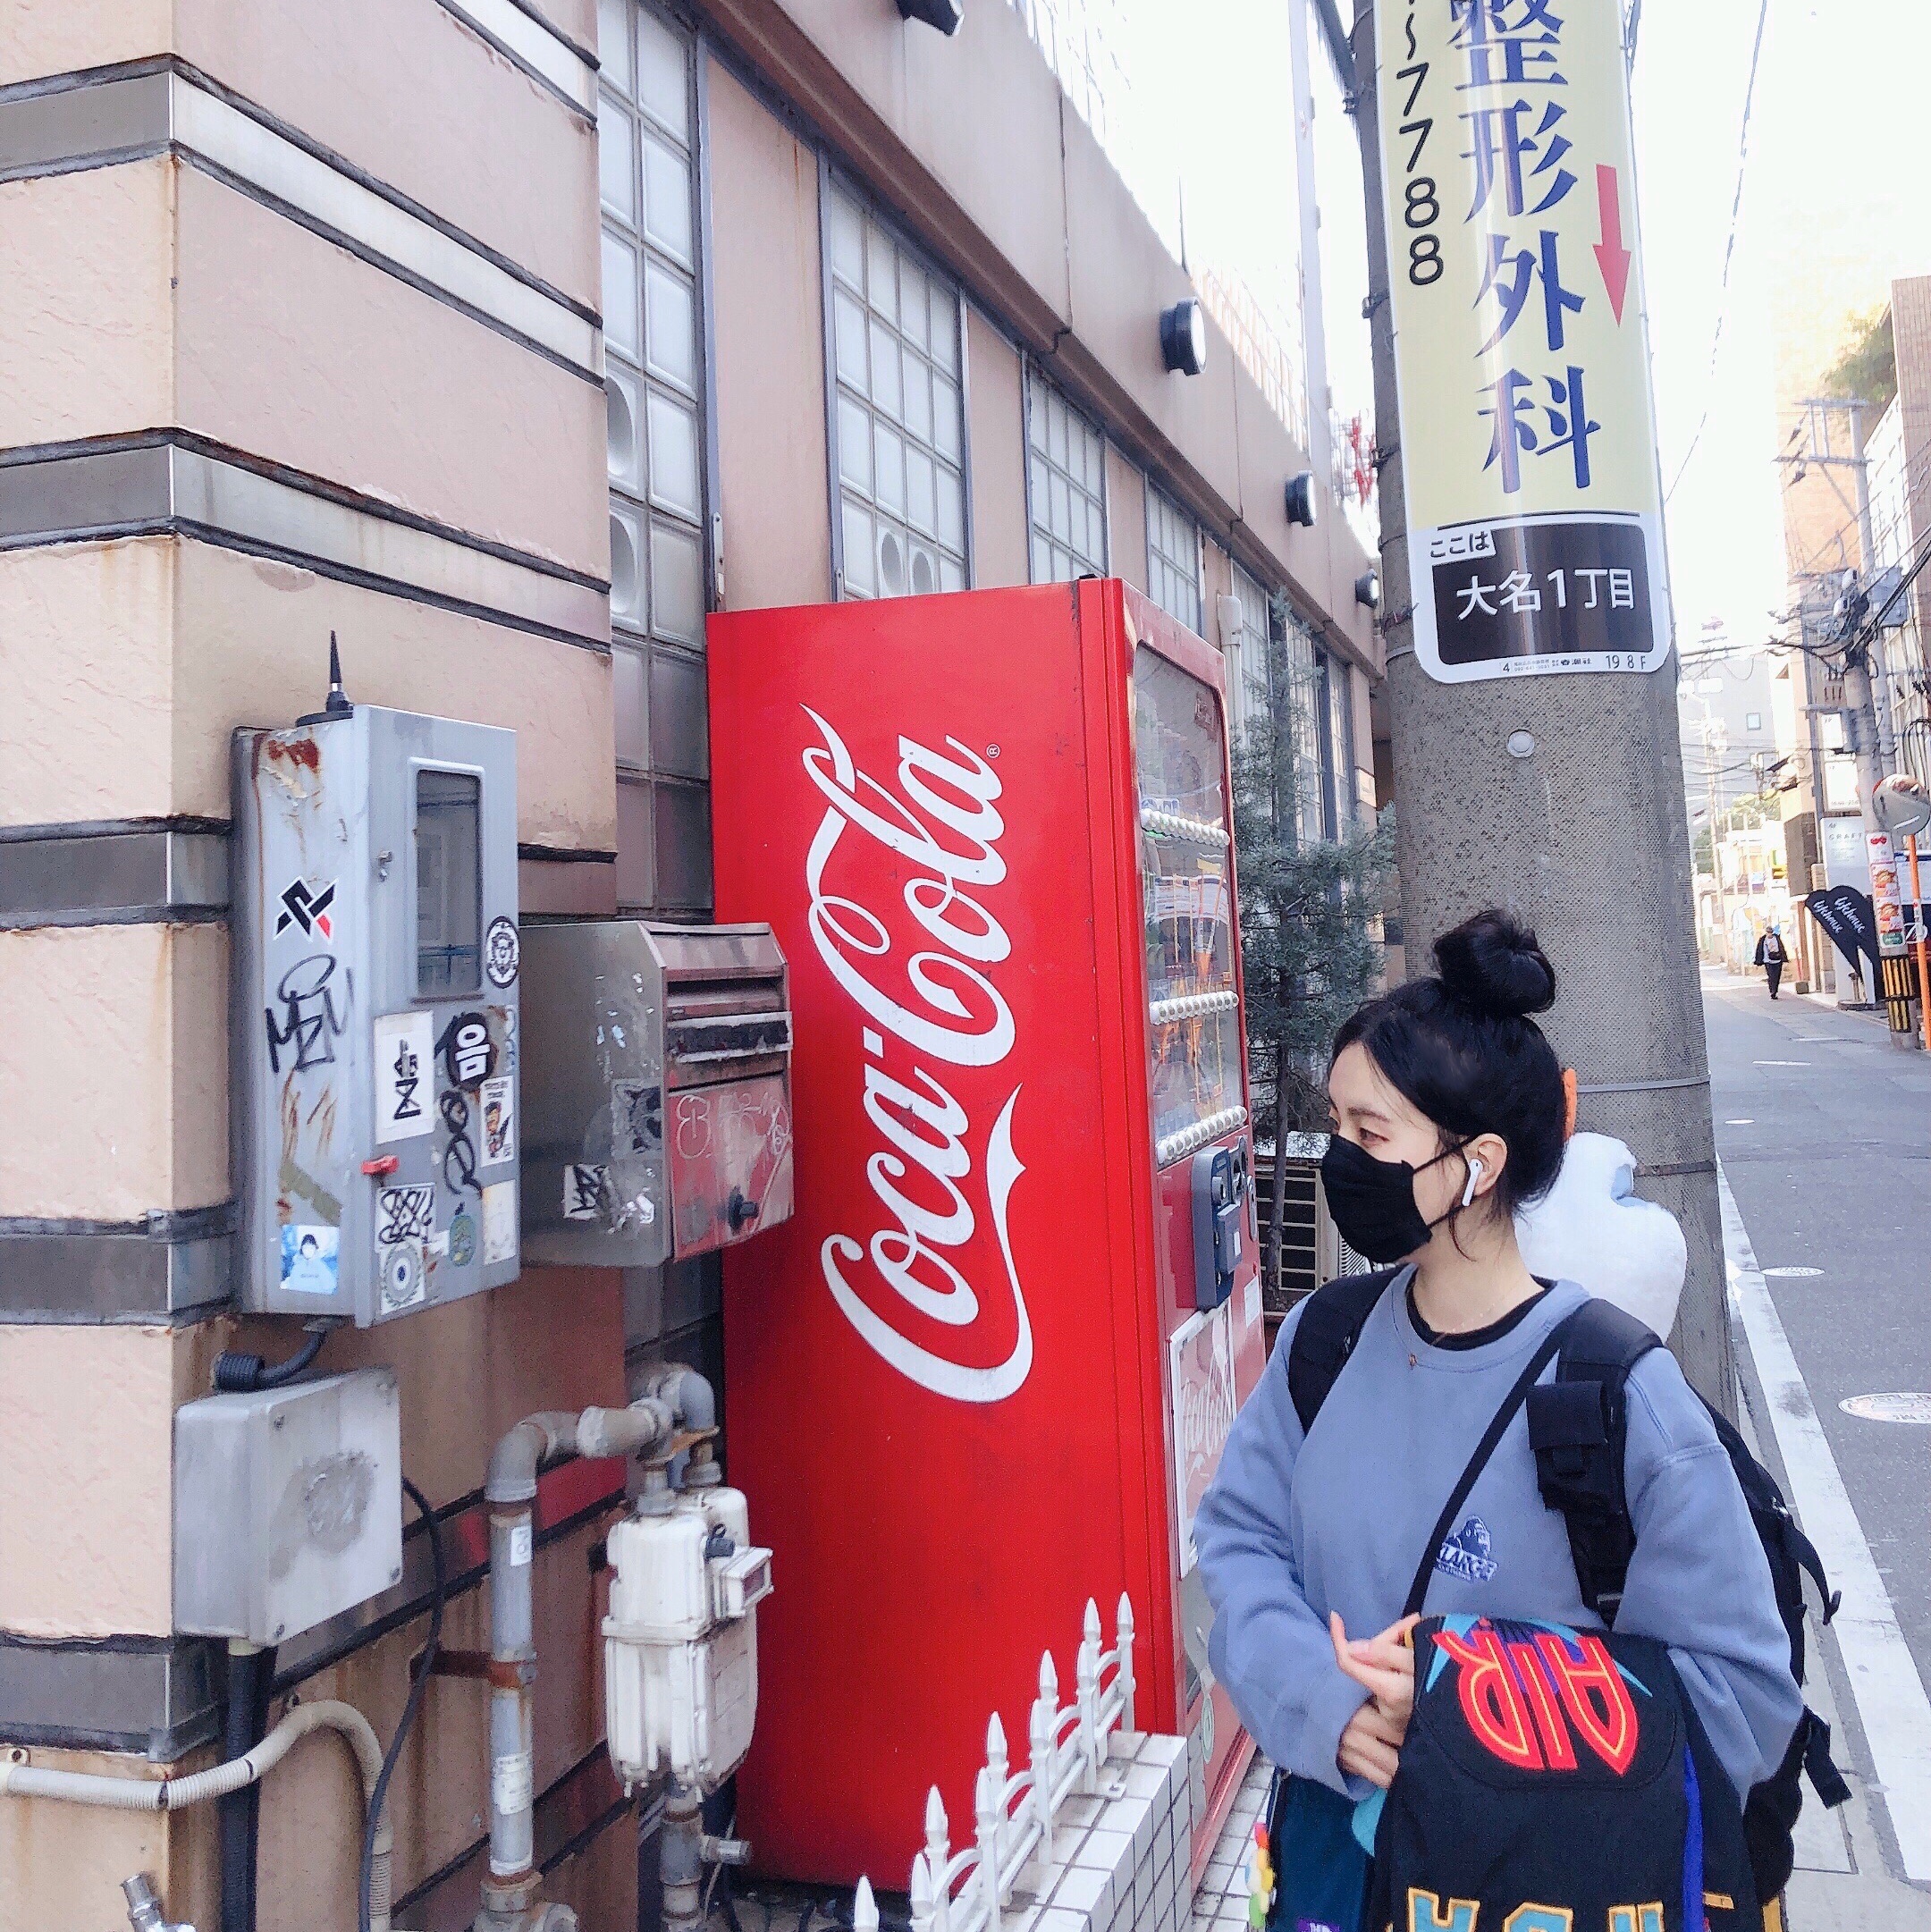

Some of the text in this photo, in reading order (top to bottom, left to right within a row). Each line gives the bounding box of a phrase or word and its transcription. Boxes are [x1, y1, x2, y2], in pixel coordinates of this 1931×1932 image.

[1446, 0, 1602, 494] 整形外科
[1430, 530, 1491, 558] ここは
[1456, 568, 1635, 621] 大名1丁目
[798, 703, 1033, 1404] Coca-Cola
[1432, 1629, 1640, 1776] AIR
